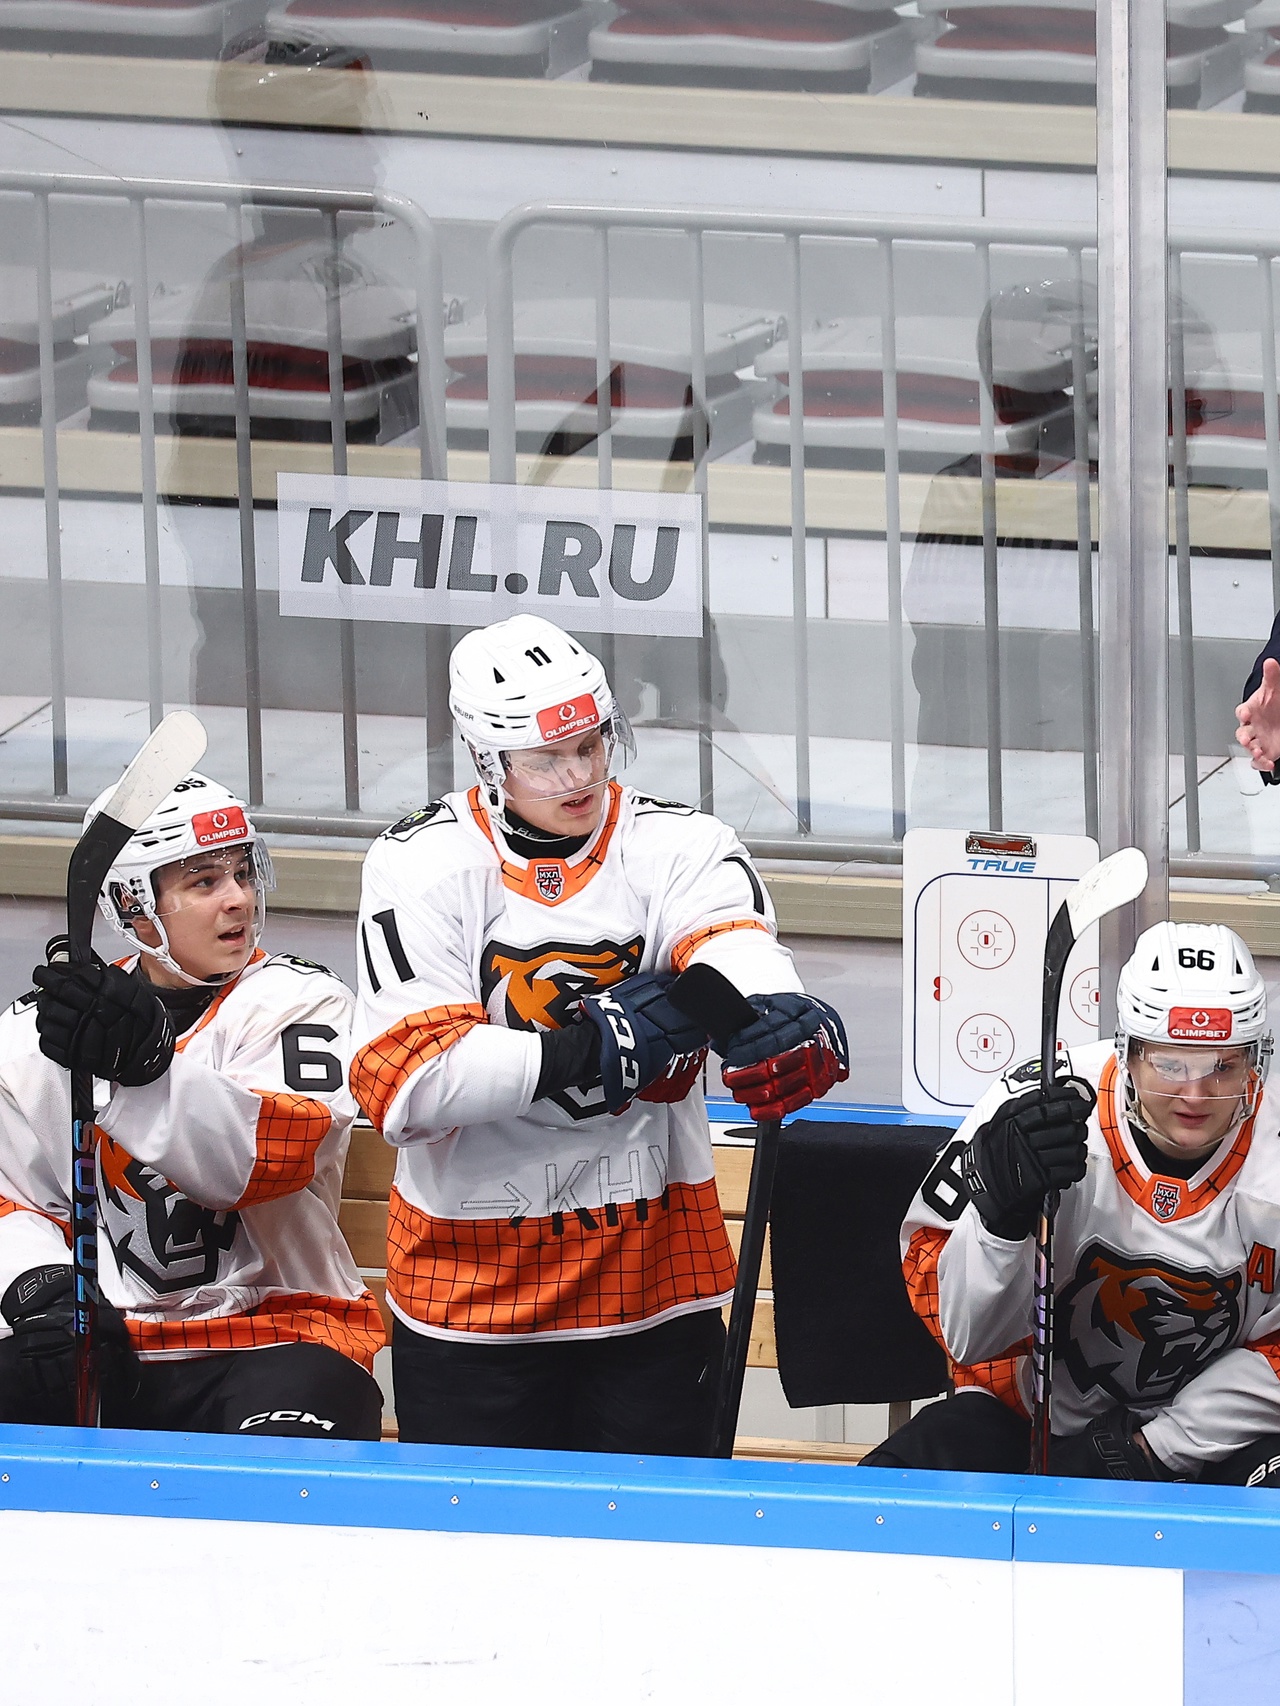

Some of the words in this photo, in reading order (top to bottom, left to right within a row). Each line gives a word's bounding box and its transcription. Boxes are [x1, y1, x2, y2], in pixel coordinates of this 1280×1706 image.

[301, 507, 681, 601] KHL.RU
[524, 646, 552, 667] 11
[545, 713, 597, 740] OLIMPBET
[199, 826, 246, 844] OLIMPBET
[538, 871, 560, 879] МХЛ
[966, 859, 1037, 874] TRUE
[1178, 947, 1216, 972] 66
[1171, 1027, 1228, 1039] OLIMPBET
[281, 1023, 344, 1093] 6
[1157, 1187, 1177, 1199] МХЛ
[73, 1118, 100, 1306] SOYUZ
[1247, 1241, 1276, 1295] A
[238, 1409, 338, 1432] CCM
